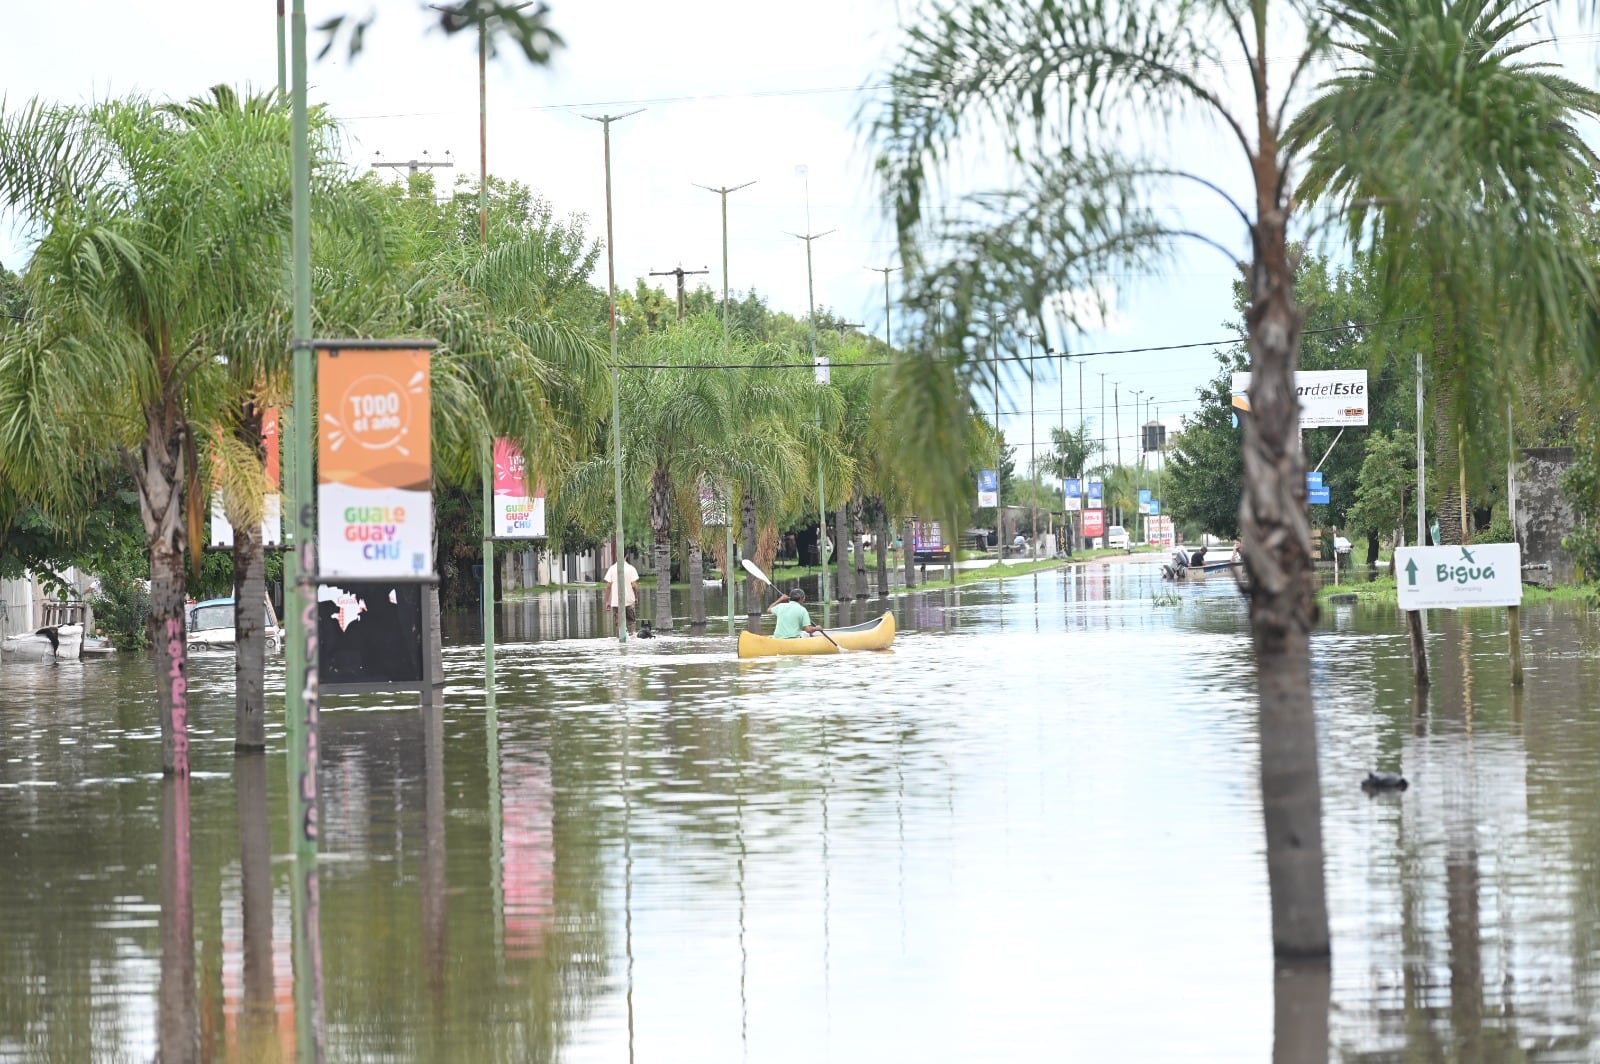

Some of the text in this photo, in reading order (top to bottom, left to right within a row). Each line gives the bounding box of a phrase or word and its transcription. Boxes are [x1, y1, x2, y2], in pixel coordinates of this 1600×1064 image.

[1296, 382, 1364, 396] ardelEste
[350, 392, 399, 416] TODO
[353, 416, 400, 432] el año
[363, 540, 400, 560] CHÚ
[1436, 562, 1495, 584] Biguá
